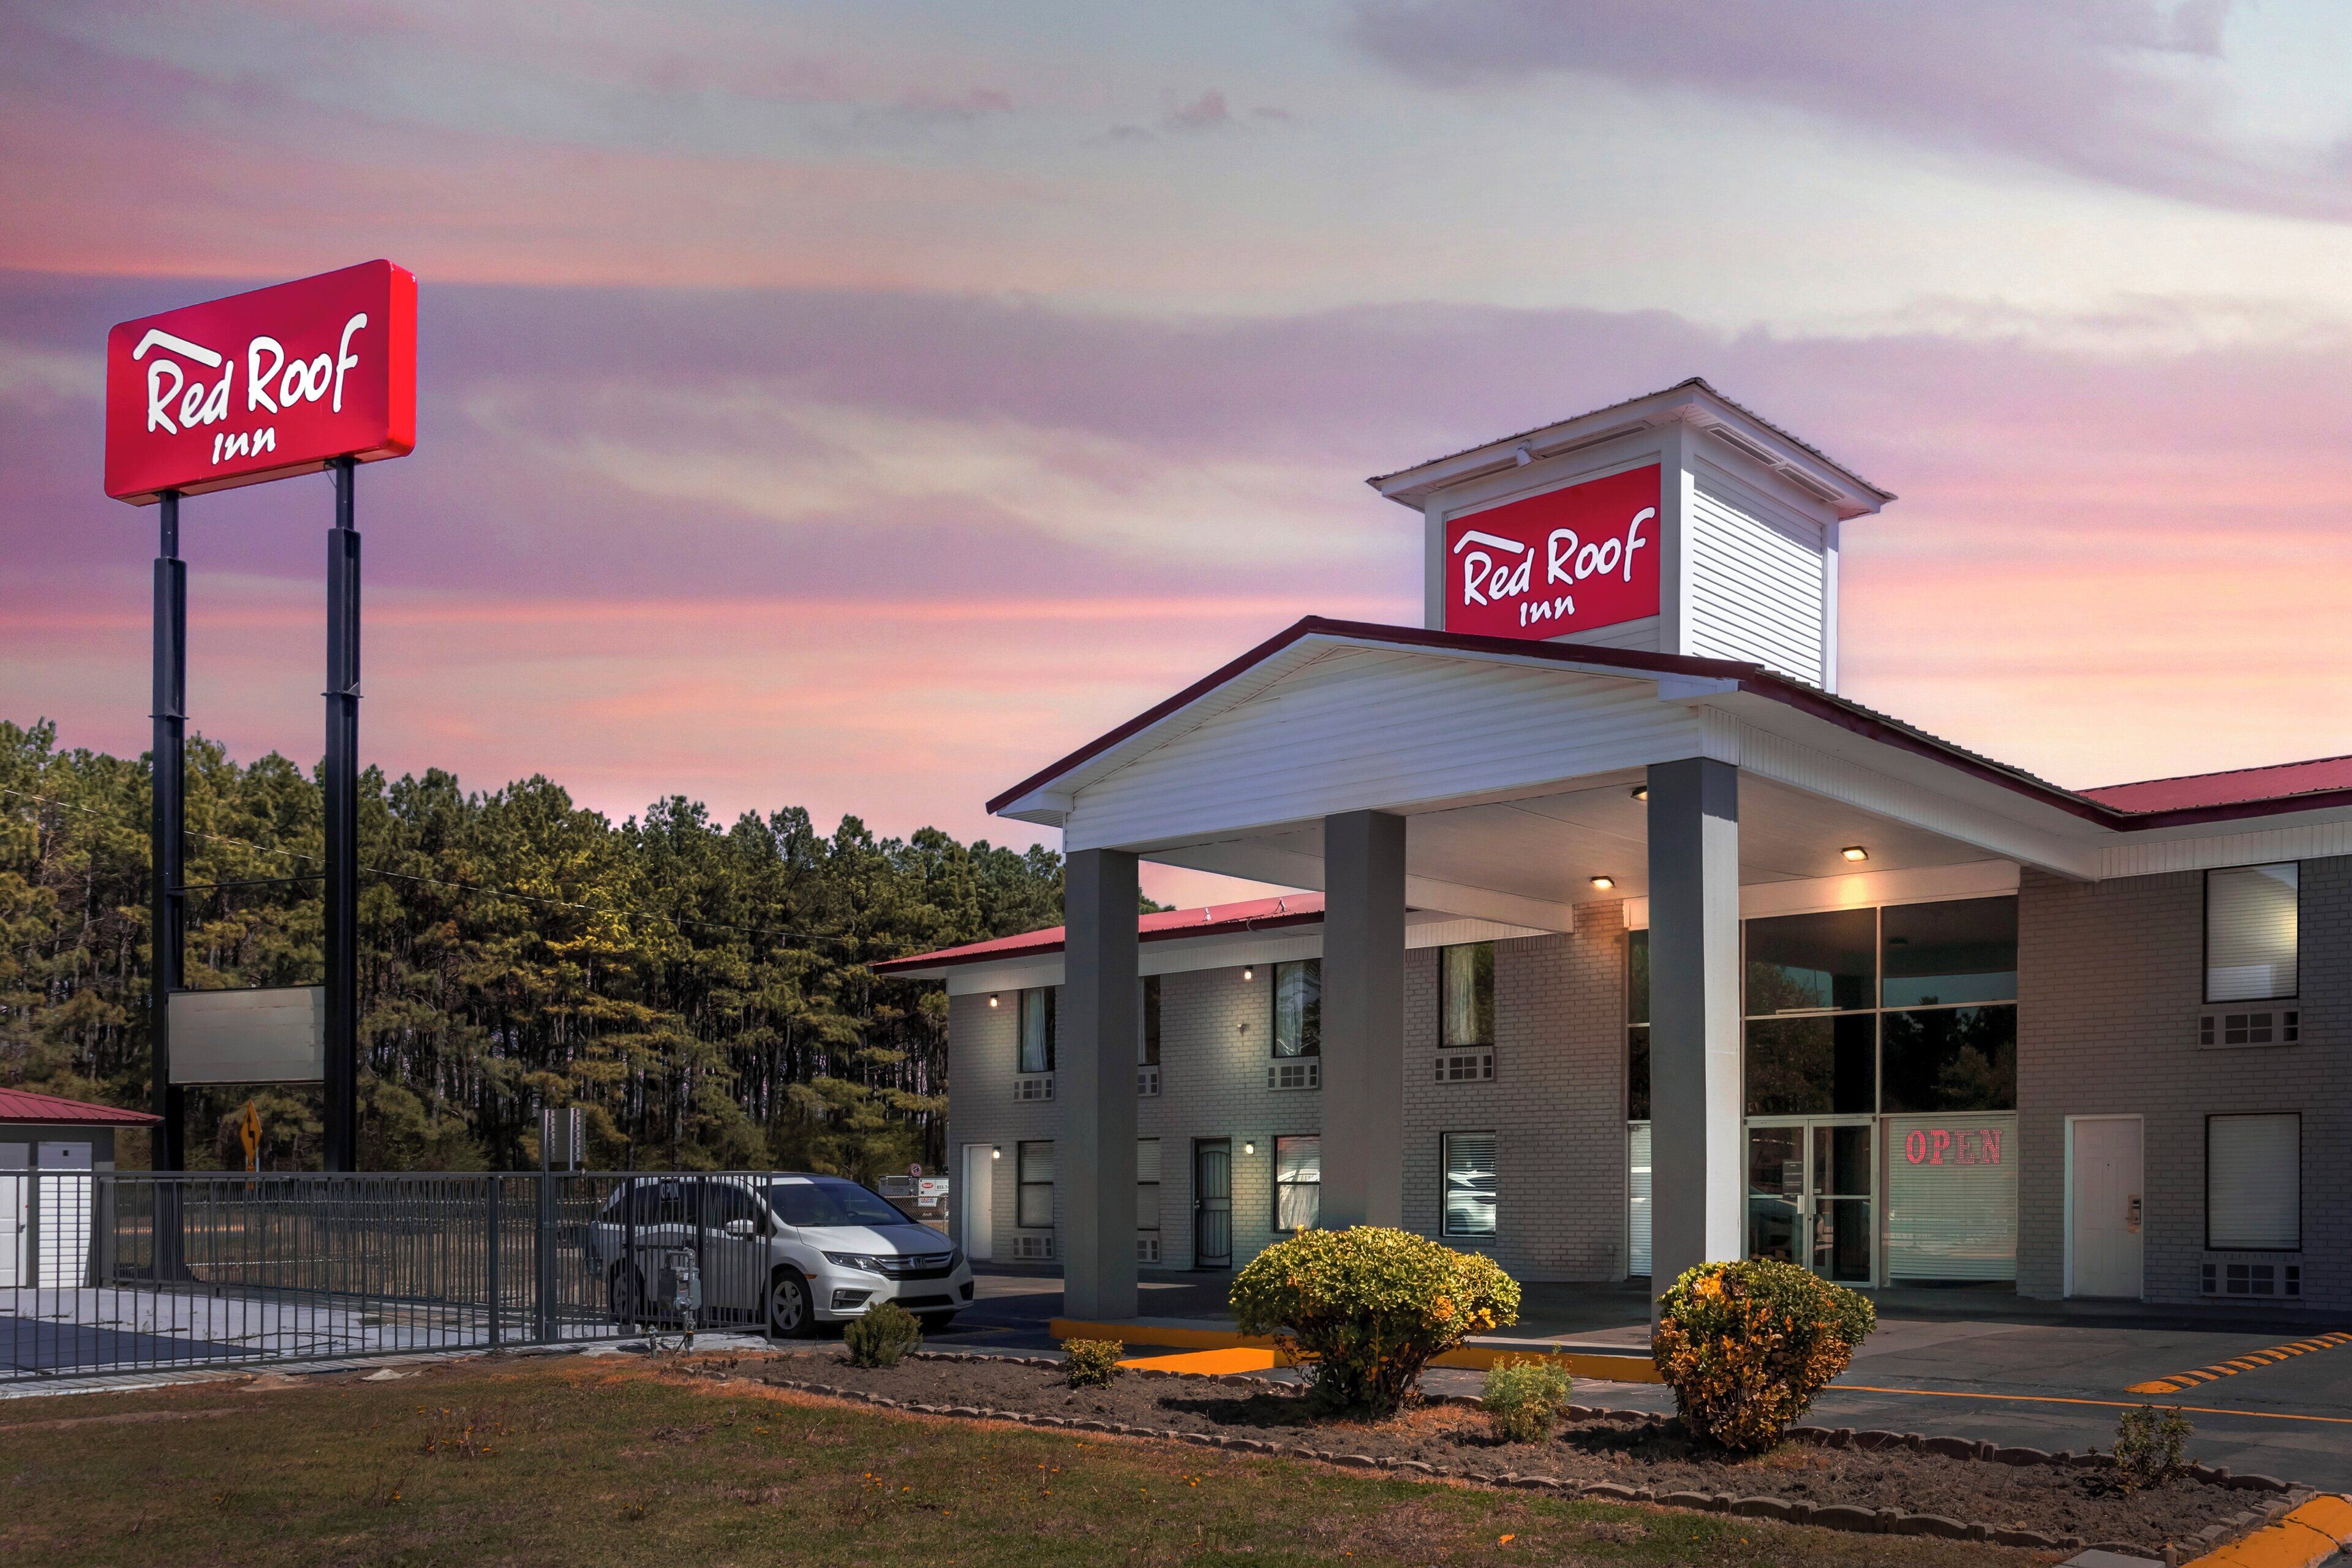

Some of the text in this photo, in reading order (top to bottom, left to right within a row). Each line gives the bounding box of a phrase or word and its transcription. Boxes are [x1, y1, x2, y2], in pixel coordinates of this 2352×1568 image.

[148, 312, 368, 435] Red Roof
[1464, 507, 1655, 606] Red Roof
[1905, 1129, 2002, 1164] OPEN
